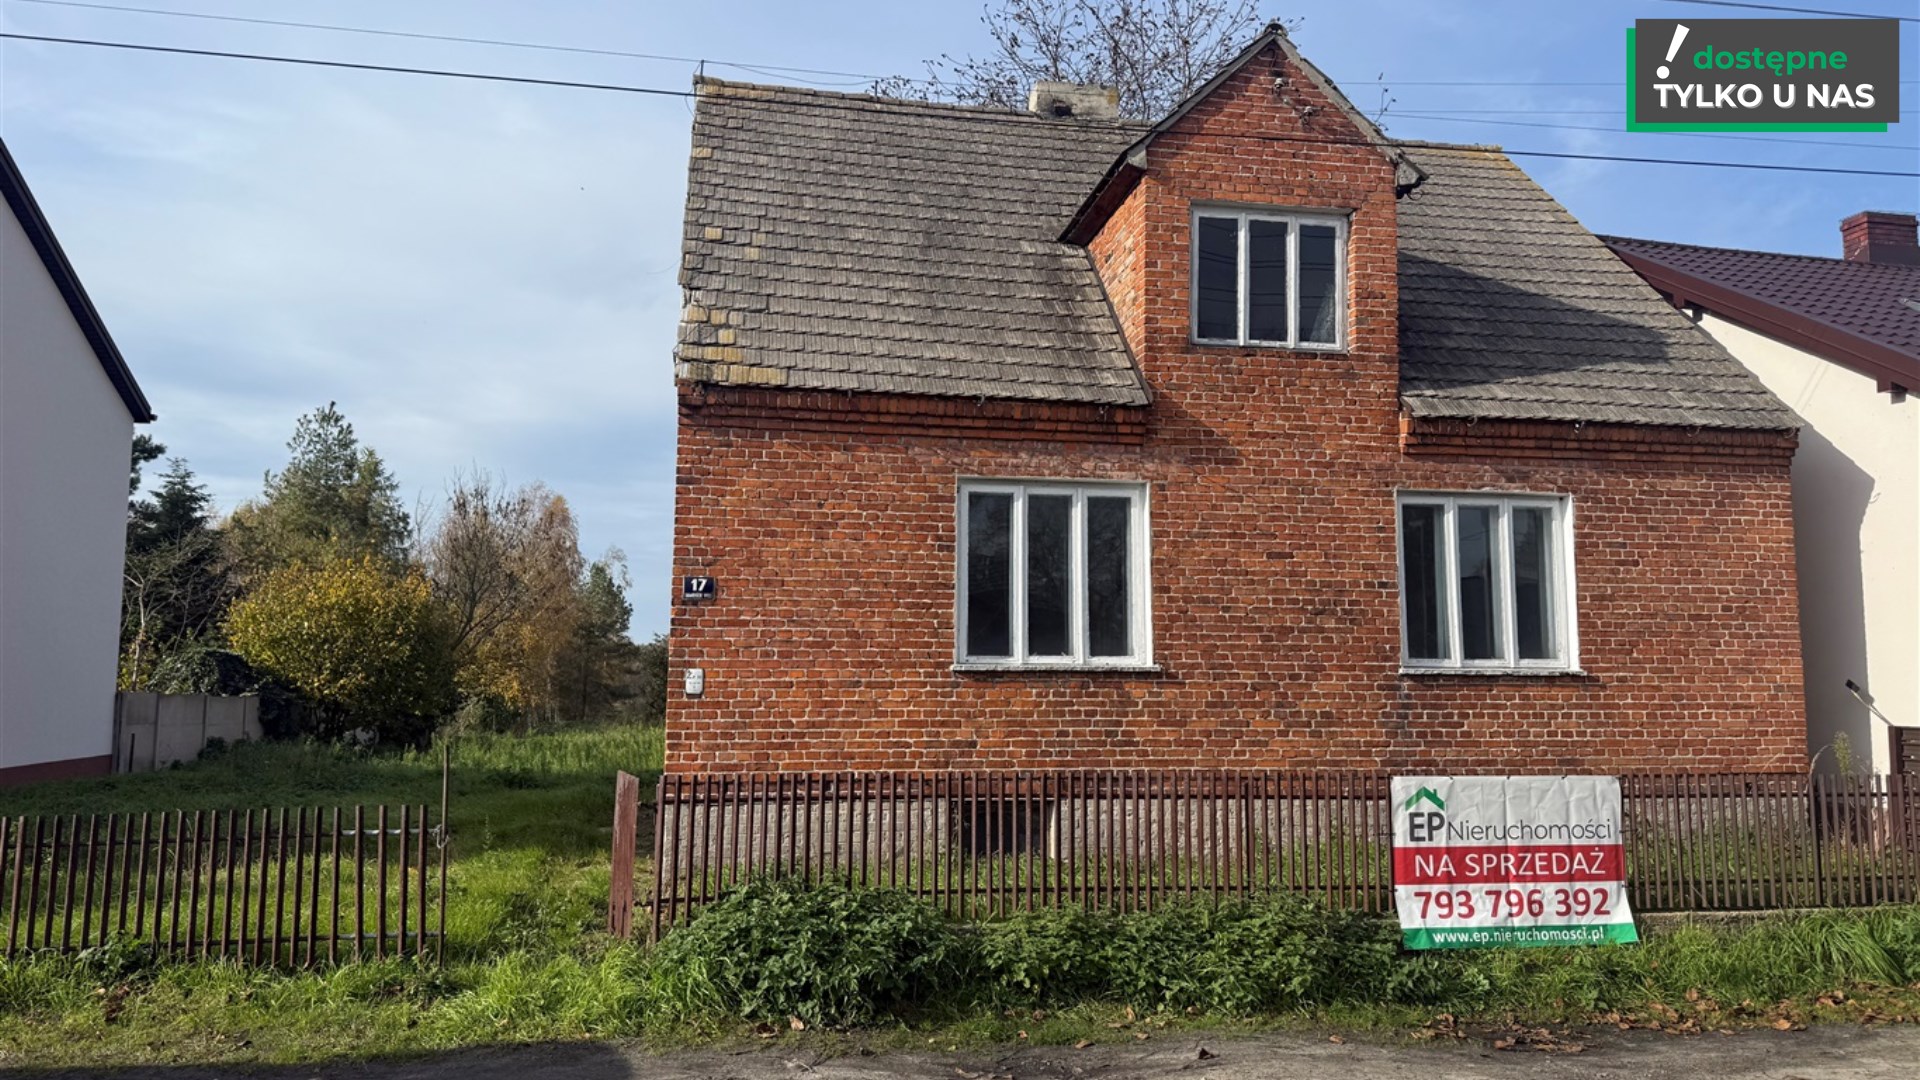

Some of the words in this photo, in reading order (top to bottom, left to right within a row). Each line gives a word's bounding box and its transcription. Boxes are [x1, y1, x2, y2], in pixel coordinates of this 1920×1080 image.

[691, 578, 708, 591] 17
[1408, 811, 1445, 842] EP
[1448, 818, 1612, 841] Nieruchomości
[1415, 854, 1456, 877] NA
[1465, 847, 1606, 876] SPRZEDAŻ
[1413, 890, 1475, 919] 793
[1485, 889, 1544, 918] 796
[1555, 888, 1611, 917] 392
